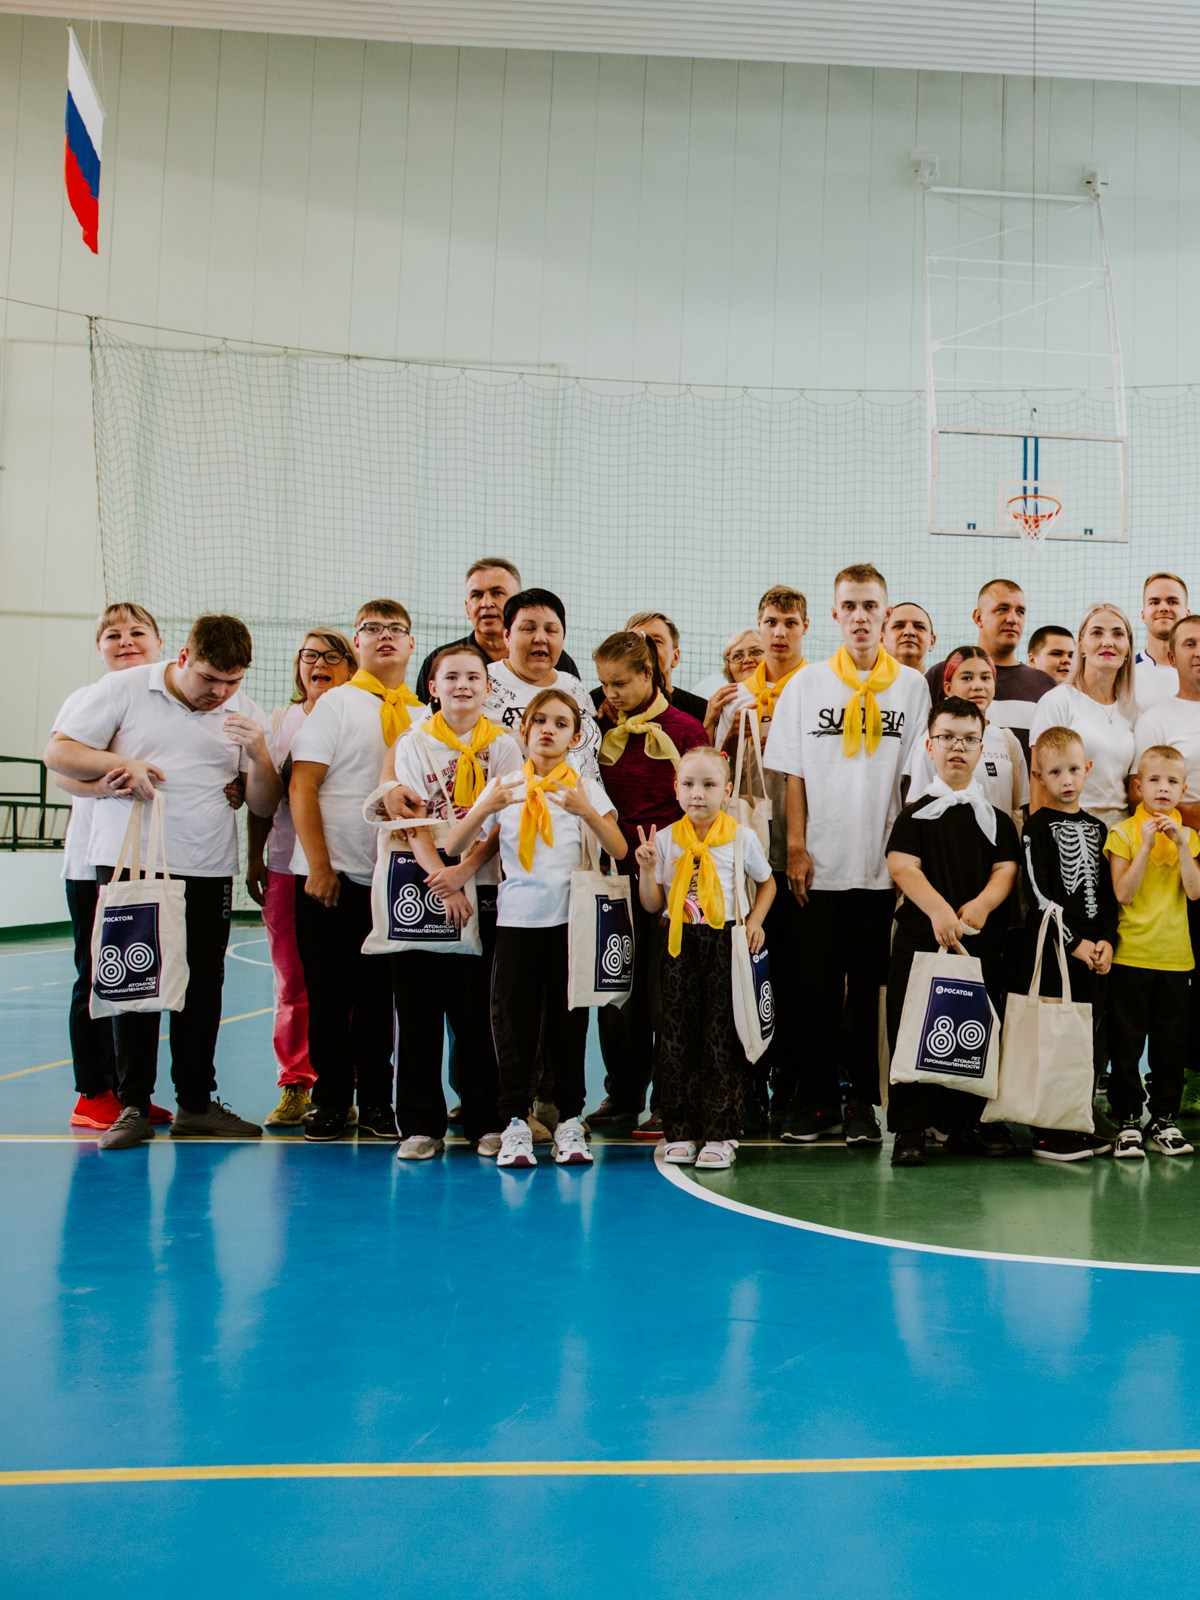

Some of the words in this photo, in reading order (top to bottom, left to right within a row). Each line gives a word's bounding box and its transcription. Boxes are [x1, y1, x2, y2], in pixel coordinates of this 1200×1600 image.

[818, 707, 905, 732] SUBIA
[97, 942, 155, 987] 80
[944, 988, 973, 997] РОСАТОМ
[926, 1015, 986, 1058] 80
[923, 1057, 980, 1070] ПРОМЫШЛЕННОСТИ
[953, 1057, 981, 1065] АТОМНОЙ
